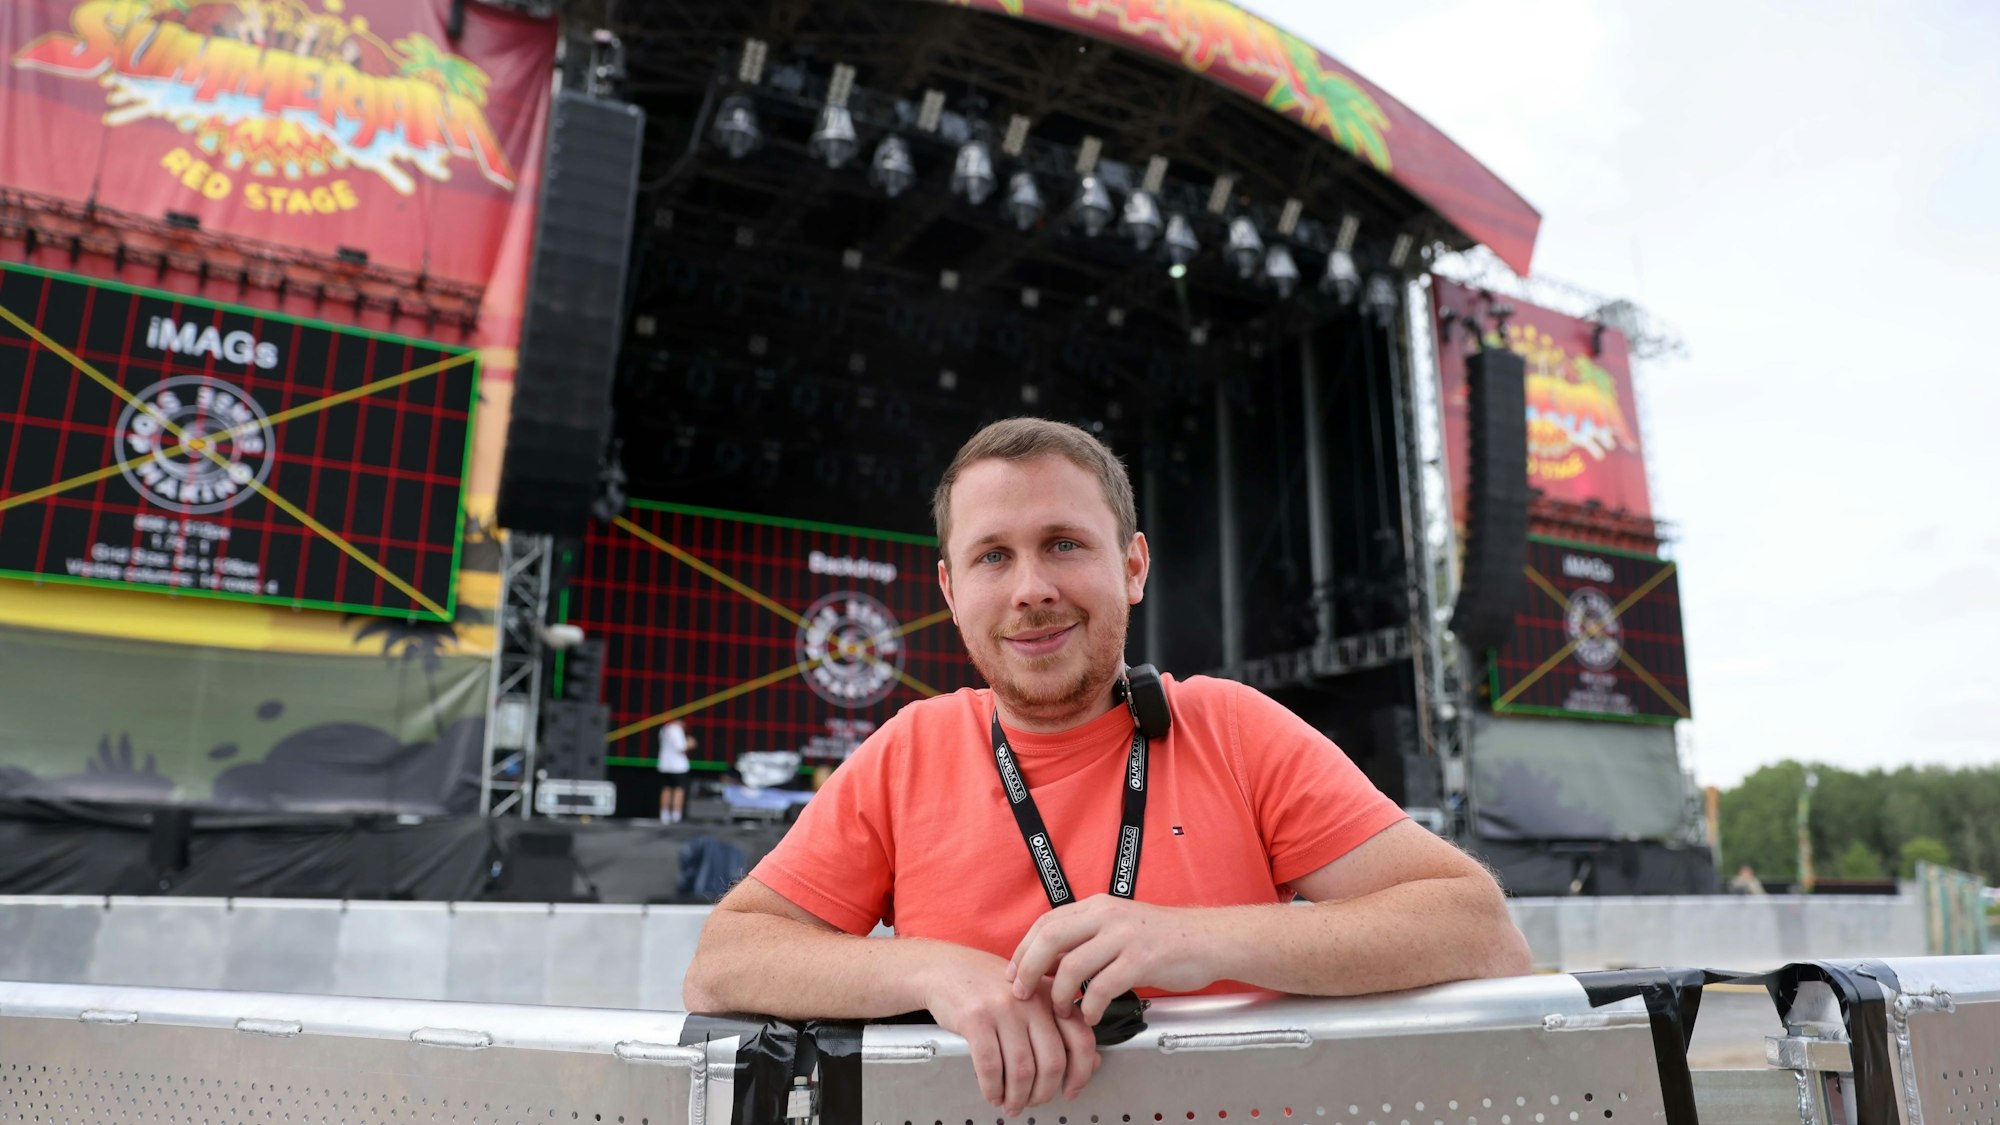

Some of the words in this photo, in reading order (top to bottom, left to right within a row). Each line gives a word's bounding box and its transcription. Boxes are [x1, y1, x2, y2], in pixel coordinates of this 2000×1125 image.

[161, 147, 232, 200] RED
[243, 179, 359, 214] STAGE
[145, 316, 279, 370] iMAGs
[808, 551, 897, 585] Backdrop
[1038, 844, 1066, 899] LIVEMODUS
[1118, 827, 1134, 882] LIVEMODUS
